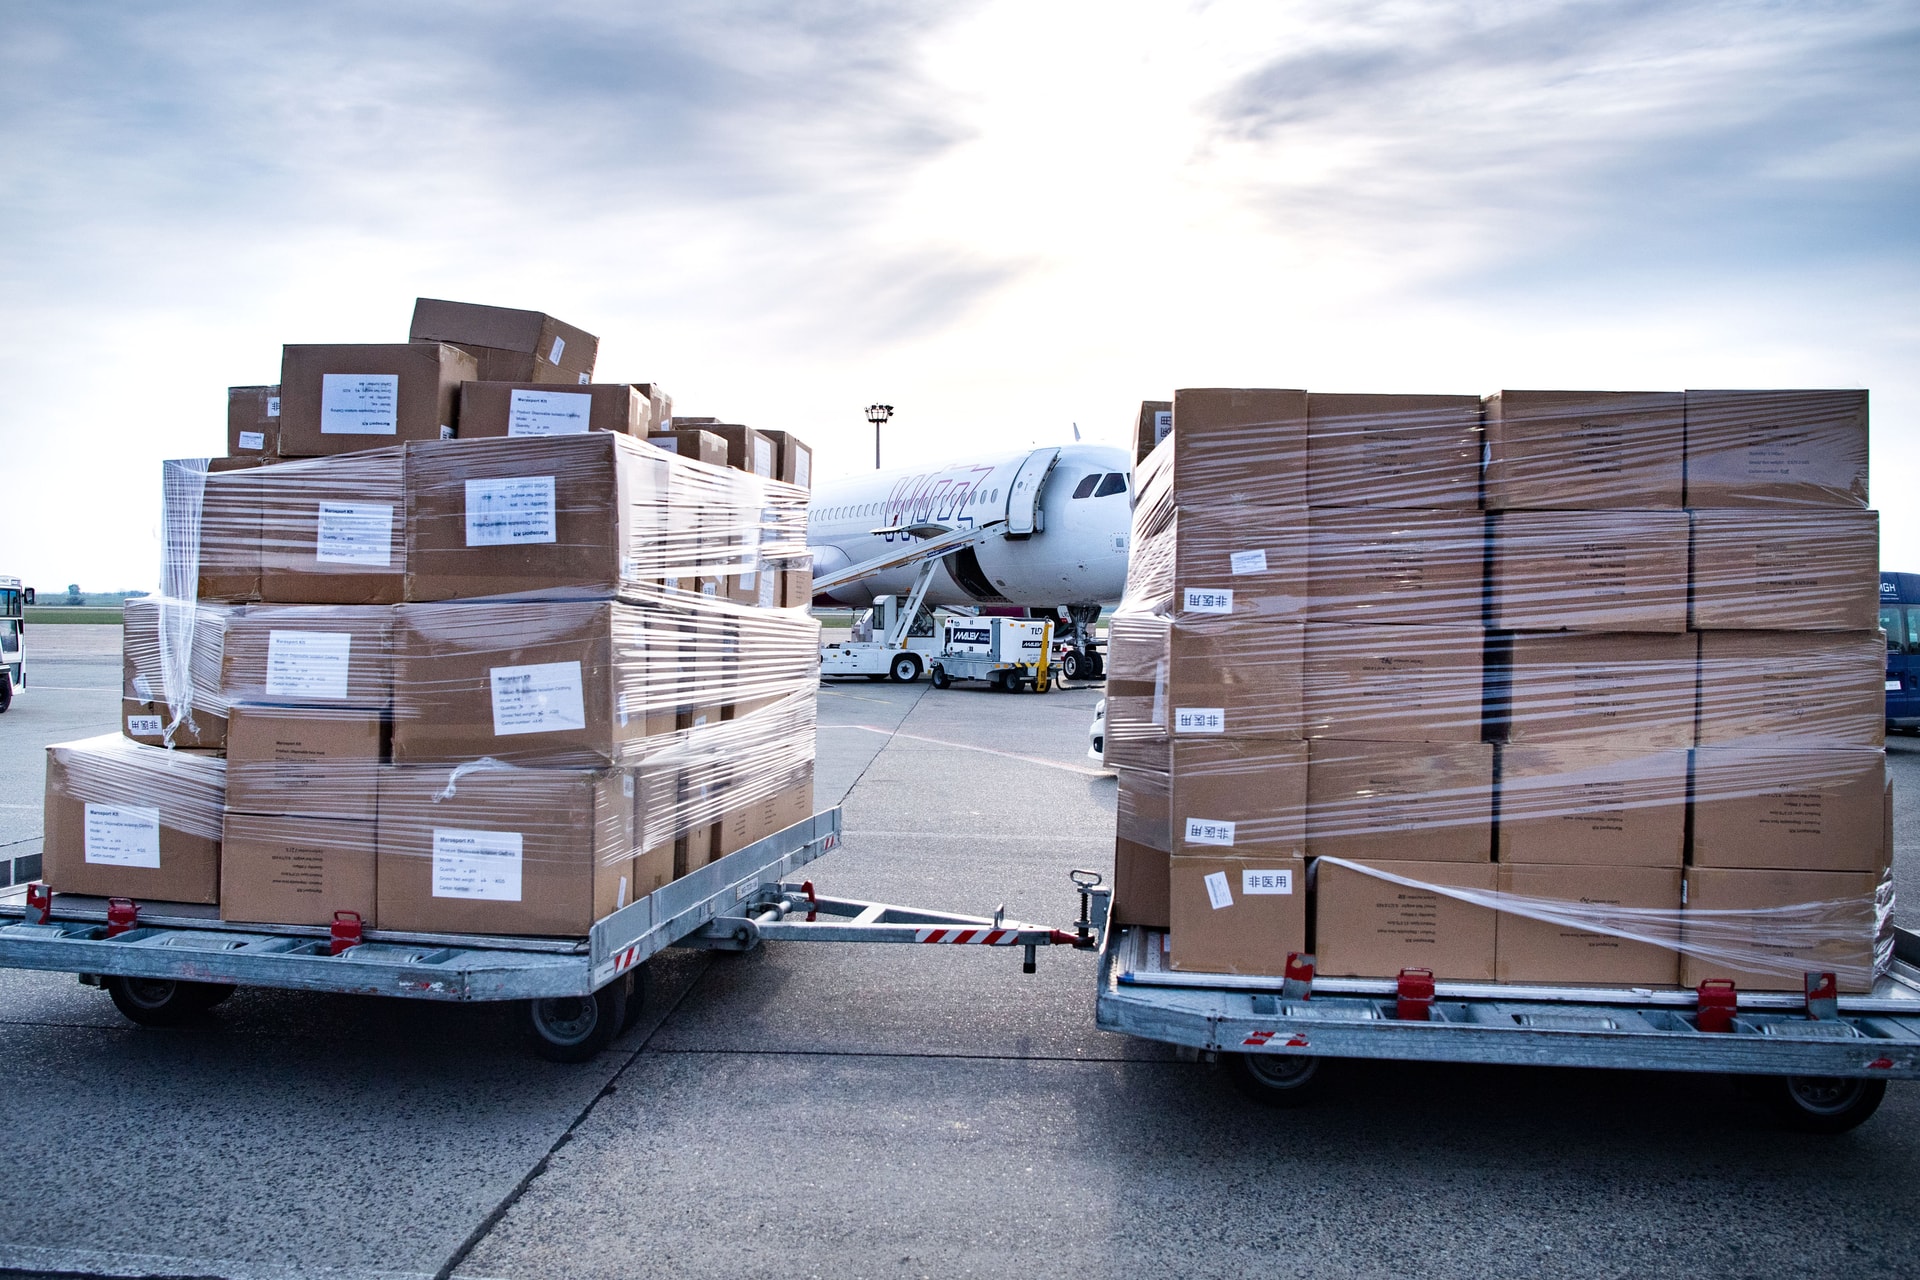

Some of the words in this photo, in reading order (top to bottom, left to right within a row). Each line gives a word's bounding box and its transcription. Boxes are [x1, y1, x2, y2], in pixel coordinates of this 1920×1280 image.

[1189, 594, 1228, 607] 非医用
[1181, 714, 1219, 726] 非医用
[1191, 824, 1229, 839] 非医用
[1248, 875, 1286, 888] 非医用
